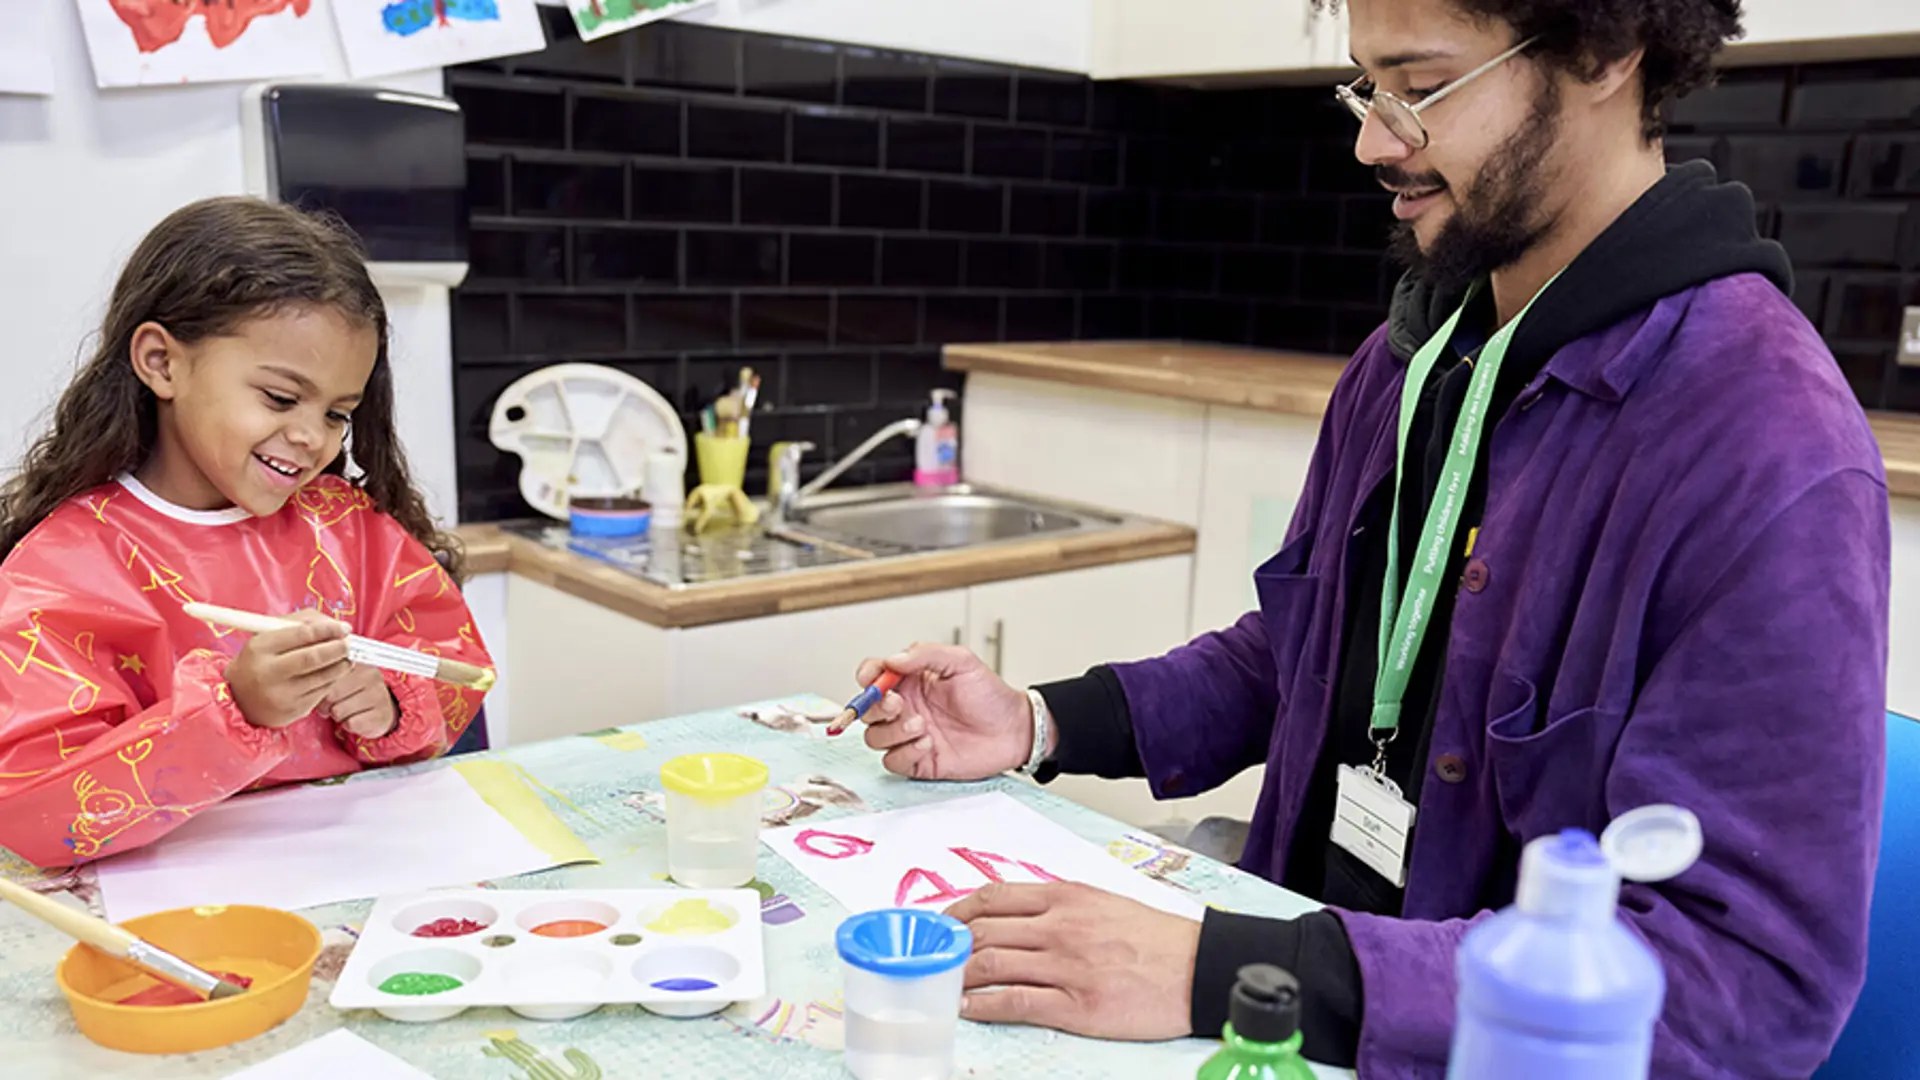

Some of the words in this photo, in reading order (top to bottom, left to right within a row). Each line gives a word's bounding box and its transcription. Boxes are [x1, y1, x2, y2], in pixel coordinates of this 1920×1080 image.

[1423, 535, 1445, 574] Putting
[1437, 493, 1455, 535] children
[1448, 471, 1462, 494] first
[1395, 631, 1417, 671] Working
[1408, 588, 1427, 631] together
